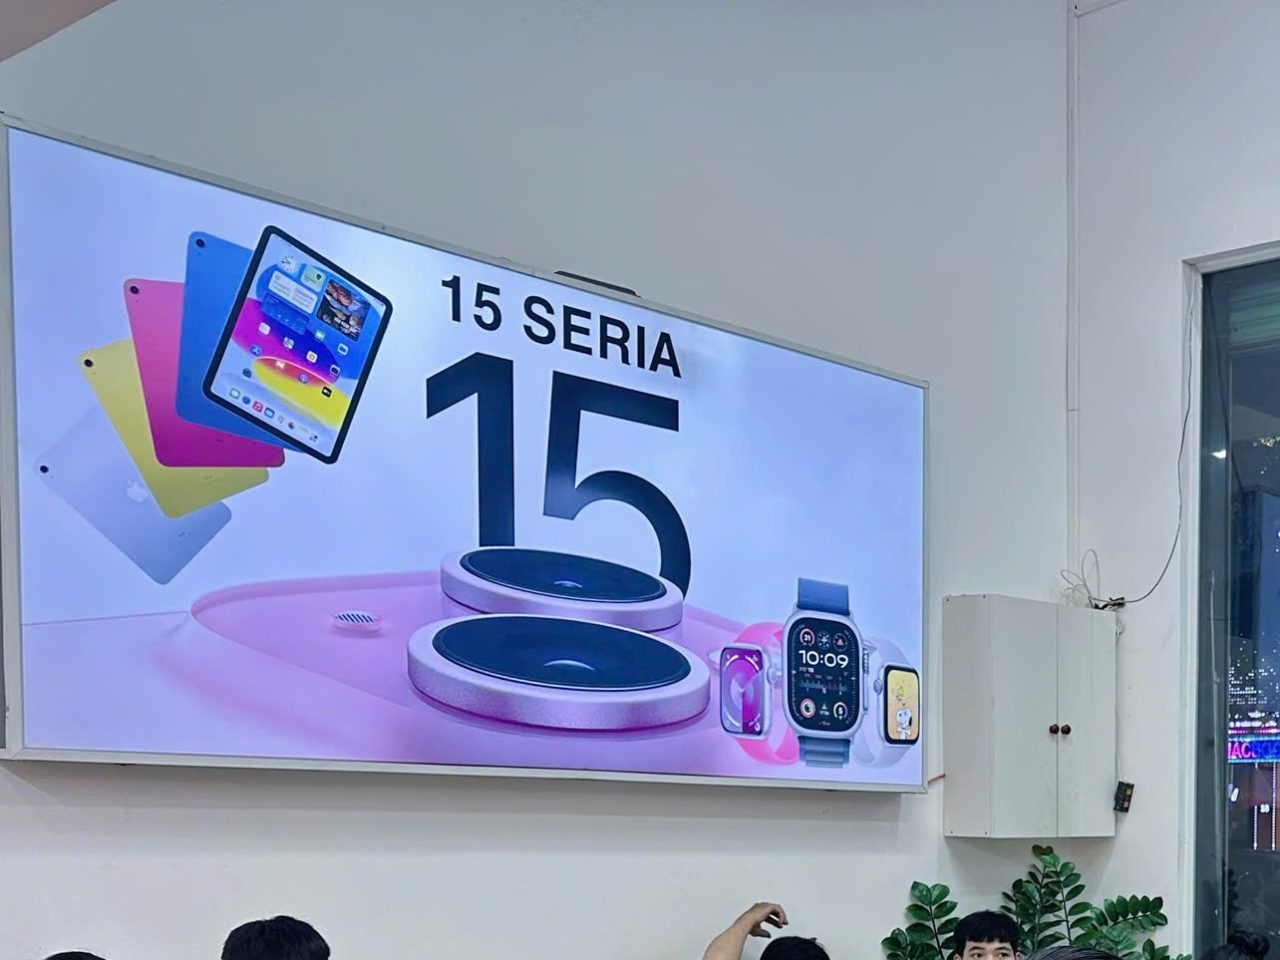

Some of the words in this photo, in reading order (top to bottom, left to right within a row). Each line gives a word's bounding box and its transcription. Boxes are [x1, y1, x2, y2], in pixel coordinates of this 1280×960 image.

[441, 274, 502, 332] 15
[523, 294, 682, 379] SERIA
[426, 351, 692, 602] 15
[798, 649, 849, 669] 10:09
